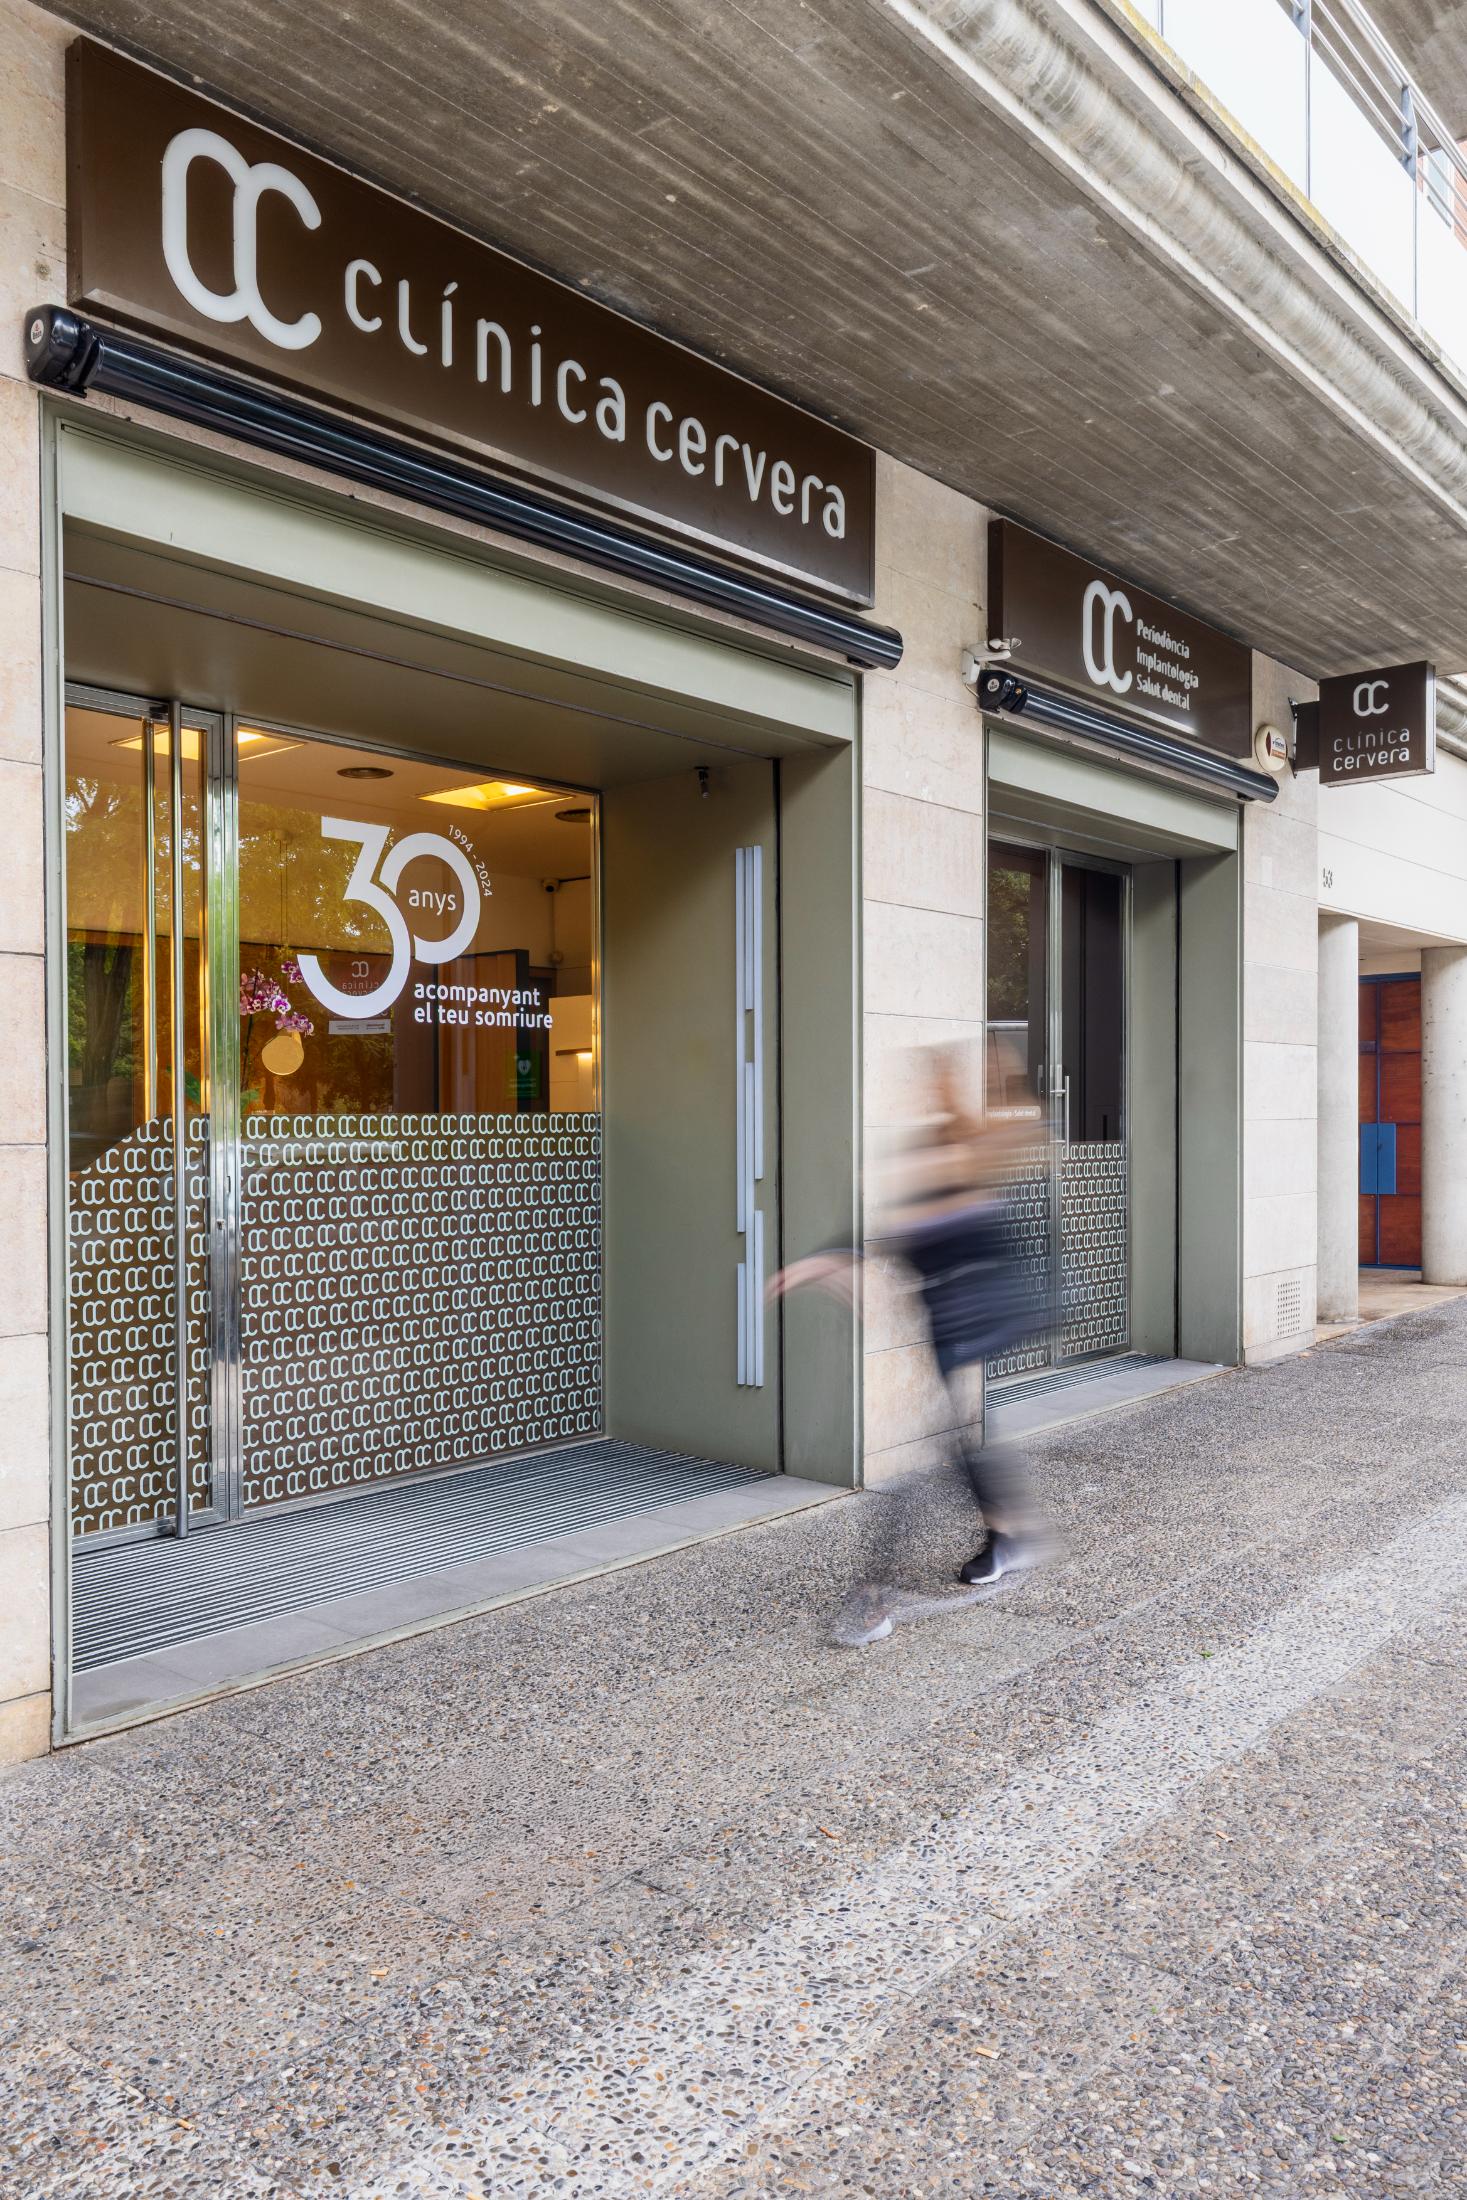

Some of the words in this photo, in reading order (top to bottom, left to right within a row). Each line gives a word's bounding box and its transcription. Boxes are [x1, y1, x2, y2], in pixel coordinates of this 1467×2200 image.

[344, 258, 627, 443] clínica
[645, 401, 847, 540] cervera
[1136, 618, 1190, 659] Periodòncia
[1136, 646, 1199, 690] Implantologia
[1136, 673, 1162, 699] Salut
[1161, 684, 1191, 711] dental
[1333, 728, 1410, 753] clínica
[1333, 747, 1410, 772] cervera
[448, 824, 474, 853] 1994
[475, 861, 493, 897] 2024
[296, 815, 481, 1019] 30
[408, 889, 456, 916] anys
[413, 983, 541, 1010] acompanyant
[414, 1002, 433, 1024] el
[437, 1004, 469, 1025] teu
[475, 1007, 554, 1029] somriure
